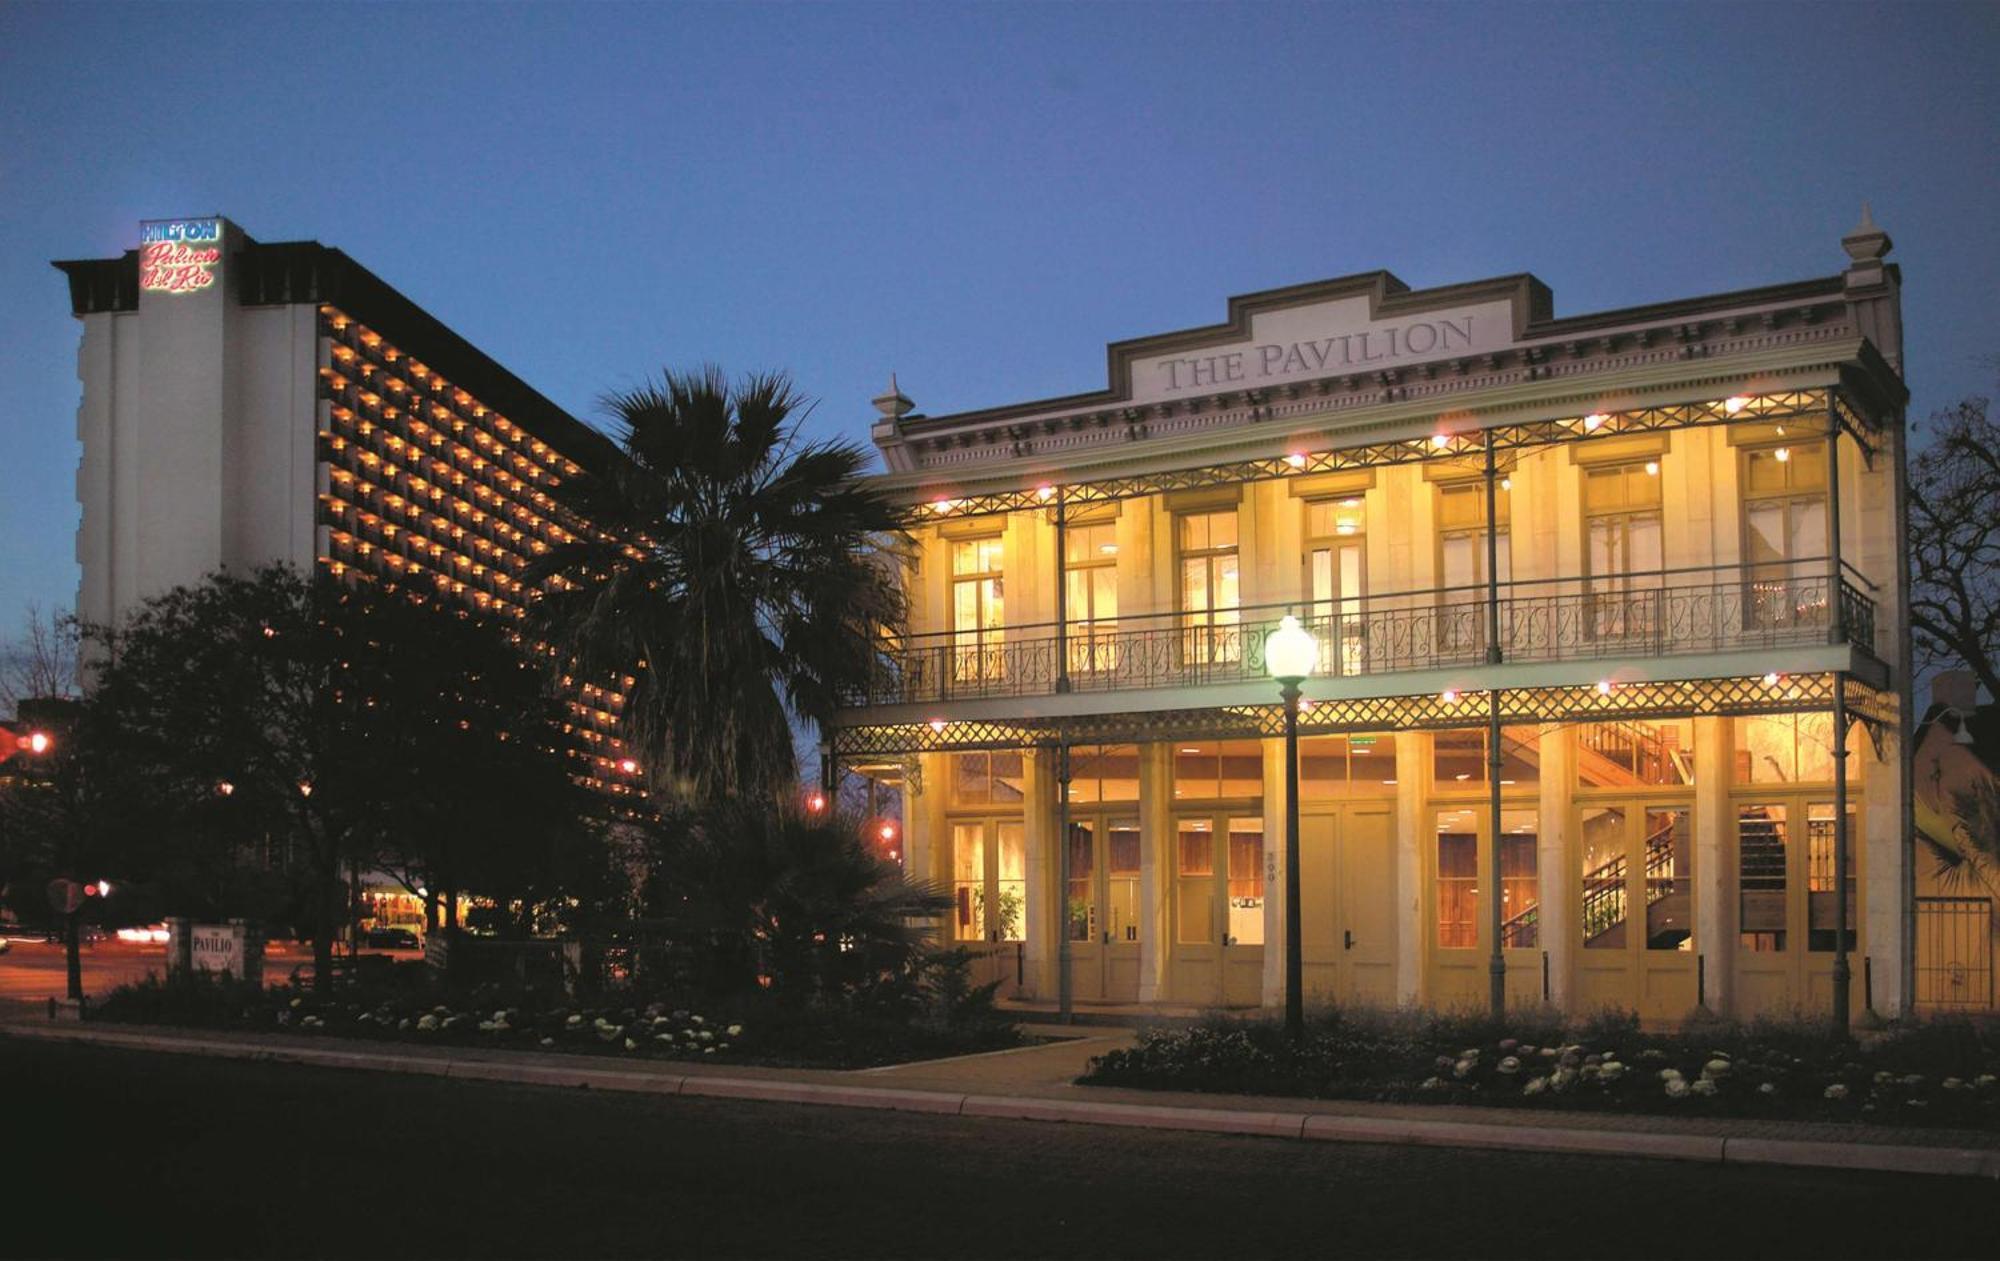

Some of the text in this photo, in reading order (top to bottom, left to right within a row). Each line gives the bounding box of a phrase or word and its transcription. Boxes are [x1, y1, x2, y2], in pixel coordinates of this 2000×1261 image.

[143, 221, 219, 241] HILTON
[1158, 316, 1474, 390] THE PAVILION
